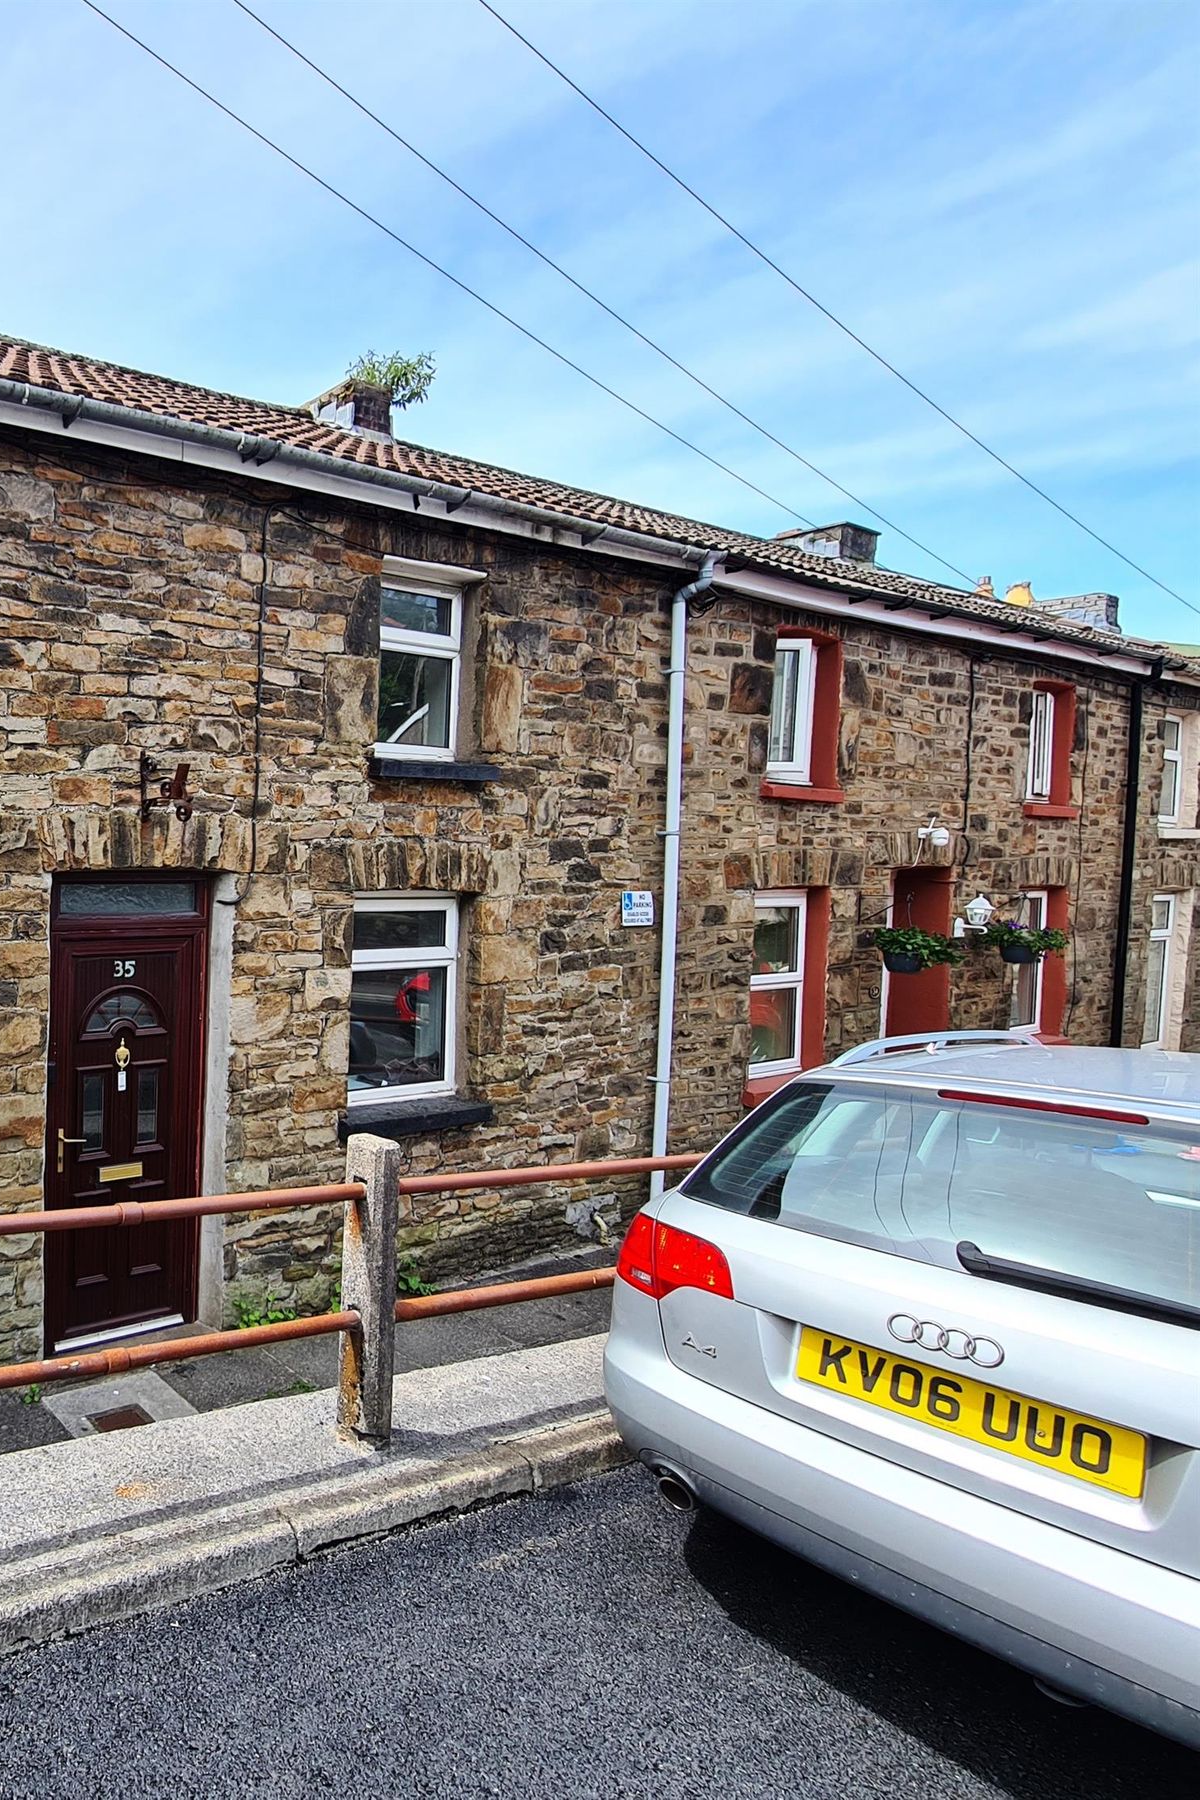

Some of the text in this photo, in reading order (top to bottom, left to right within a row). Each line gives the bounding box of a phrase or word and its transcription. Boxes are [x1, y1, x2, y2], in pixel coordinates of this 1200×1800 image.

[113, 960, 136, 977] 35
[681, 1331, 717, 1358] A4
[818, 1339, 1112, 1475] KV06 UUO
